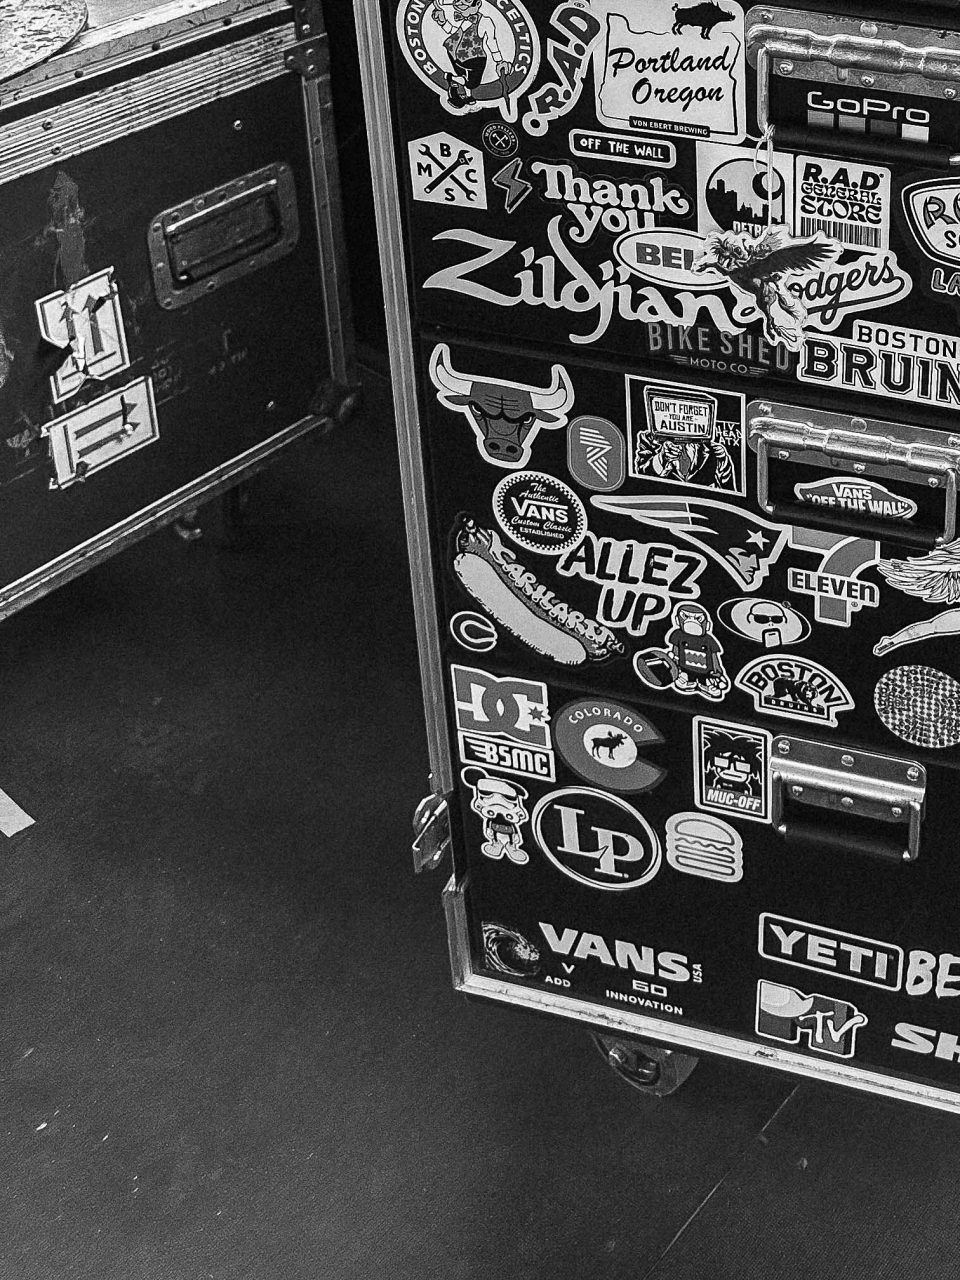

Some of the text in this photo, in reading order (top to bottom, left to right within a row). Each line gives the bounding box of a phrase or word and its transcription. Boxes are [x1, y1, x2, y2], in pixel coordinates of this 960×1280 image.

[406, 0, 437, 75] BOSTON
[608, 46, 731, 77] Portland
[632, 78, 724, 112] Oregon
[807, 91, 930, 123] GoPro
[633, 119, 708, 136] VON EBERT BREWING
[608, 141, 629, 154] THE
[634, 145, 664, 159] WALL
[531, 162, 690, 215] Thank
[800, 183, 882, 205] GENERAL
[567, 203, 655, 243] you
[800, 195, 882, 224] STORE
[422, 215, 748, 344] Zildjian
[787, 256, 896, 325] odgers
[650, 322, 789, 370] BIKE SHED
[857, 324, 958, 359] BOSTON
[690, 357, 748, 373] MOTO CO
[654, 400, 708, 417] DON'T FORGET
[660, 421, 706, 434] AUSTIN
[519, 490, 560, 503] Authentic
[530, 483, 547, 493] The
[832, 484, 873, 500] VANS
[511, 497, 569, 524] VANS
[511, 516, 572, 533] Custom Classic
[520, 527, 565, 539] ESTABLISHED
[560, 538, 702, 594] ALLEZ
[602, 588, 666, 631] UP
[745, 661, 843, 704] BOSTON
[568, 706, 643, 733] COLORADO
[480, 740, 548, 776] BSMC
[707, 788, 761, 811] MUC-OFF
[553, 804, 644, 878] LP
[538, 921, 703, 984] VANS USA
[769, 923, 889, 980] YETI
[544, 975, 572, 988] ADD
[605, 988, 684, 1016] INNOVATION
